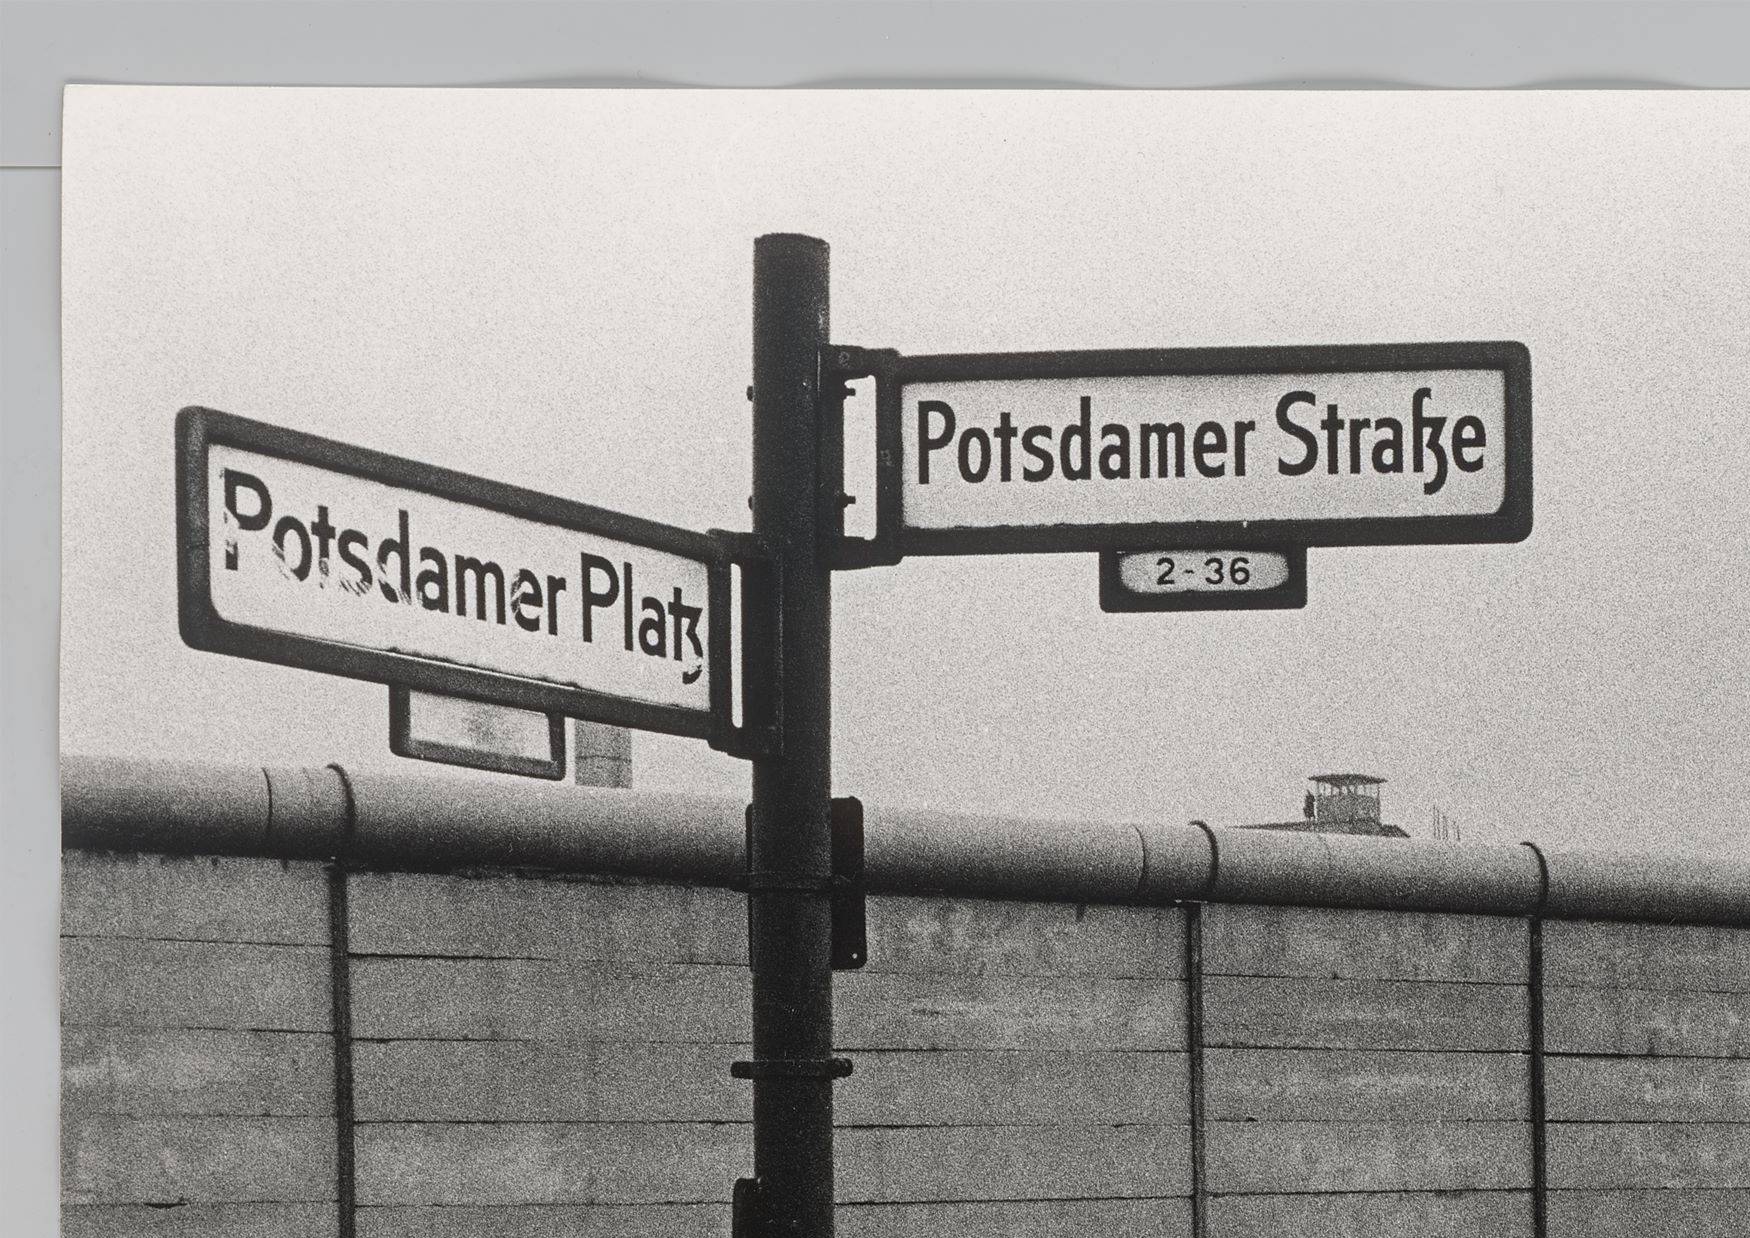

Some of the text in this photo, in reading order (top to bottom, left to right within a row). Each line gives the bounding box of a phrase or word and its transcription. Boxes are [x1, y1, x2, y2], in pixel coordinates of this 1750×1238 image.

[917, 386, 1487, 496] Potsdamer Straße
[223, 467, 704, 686] Potsdamer Platz
[1156, 556, 1251, 587] 2-36
